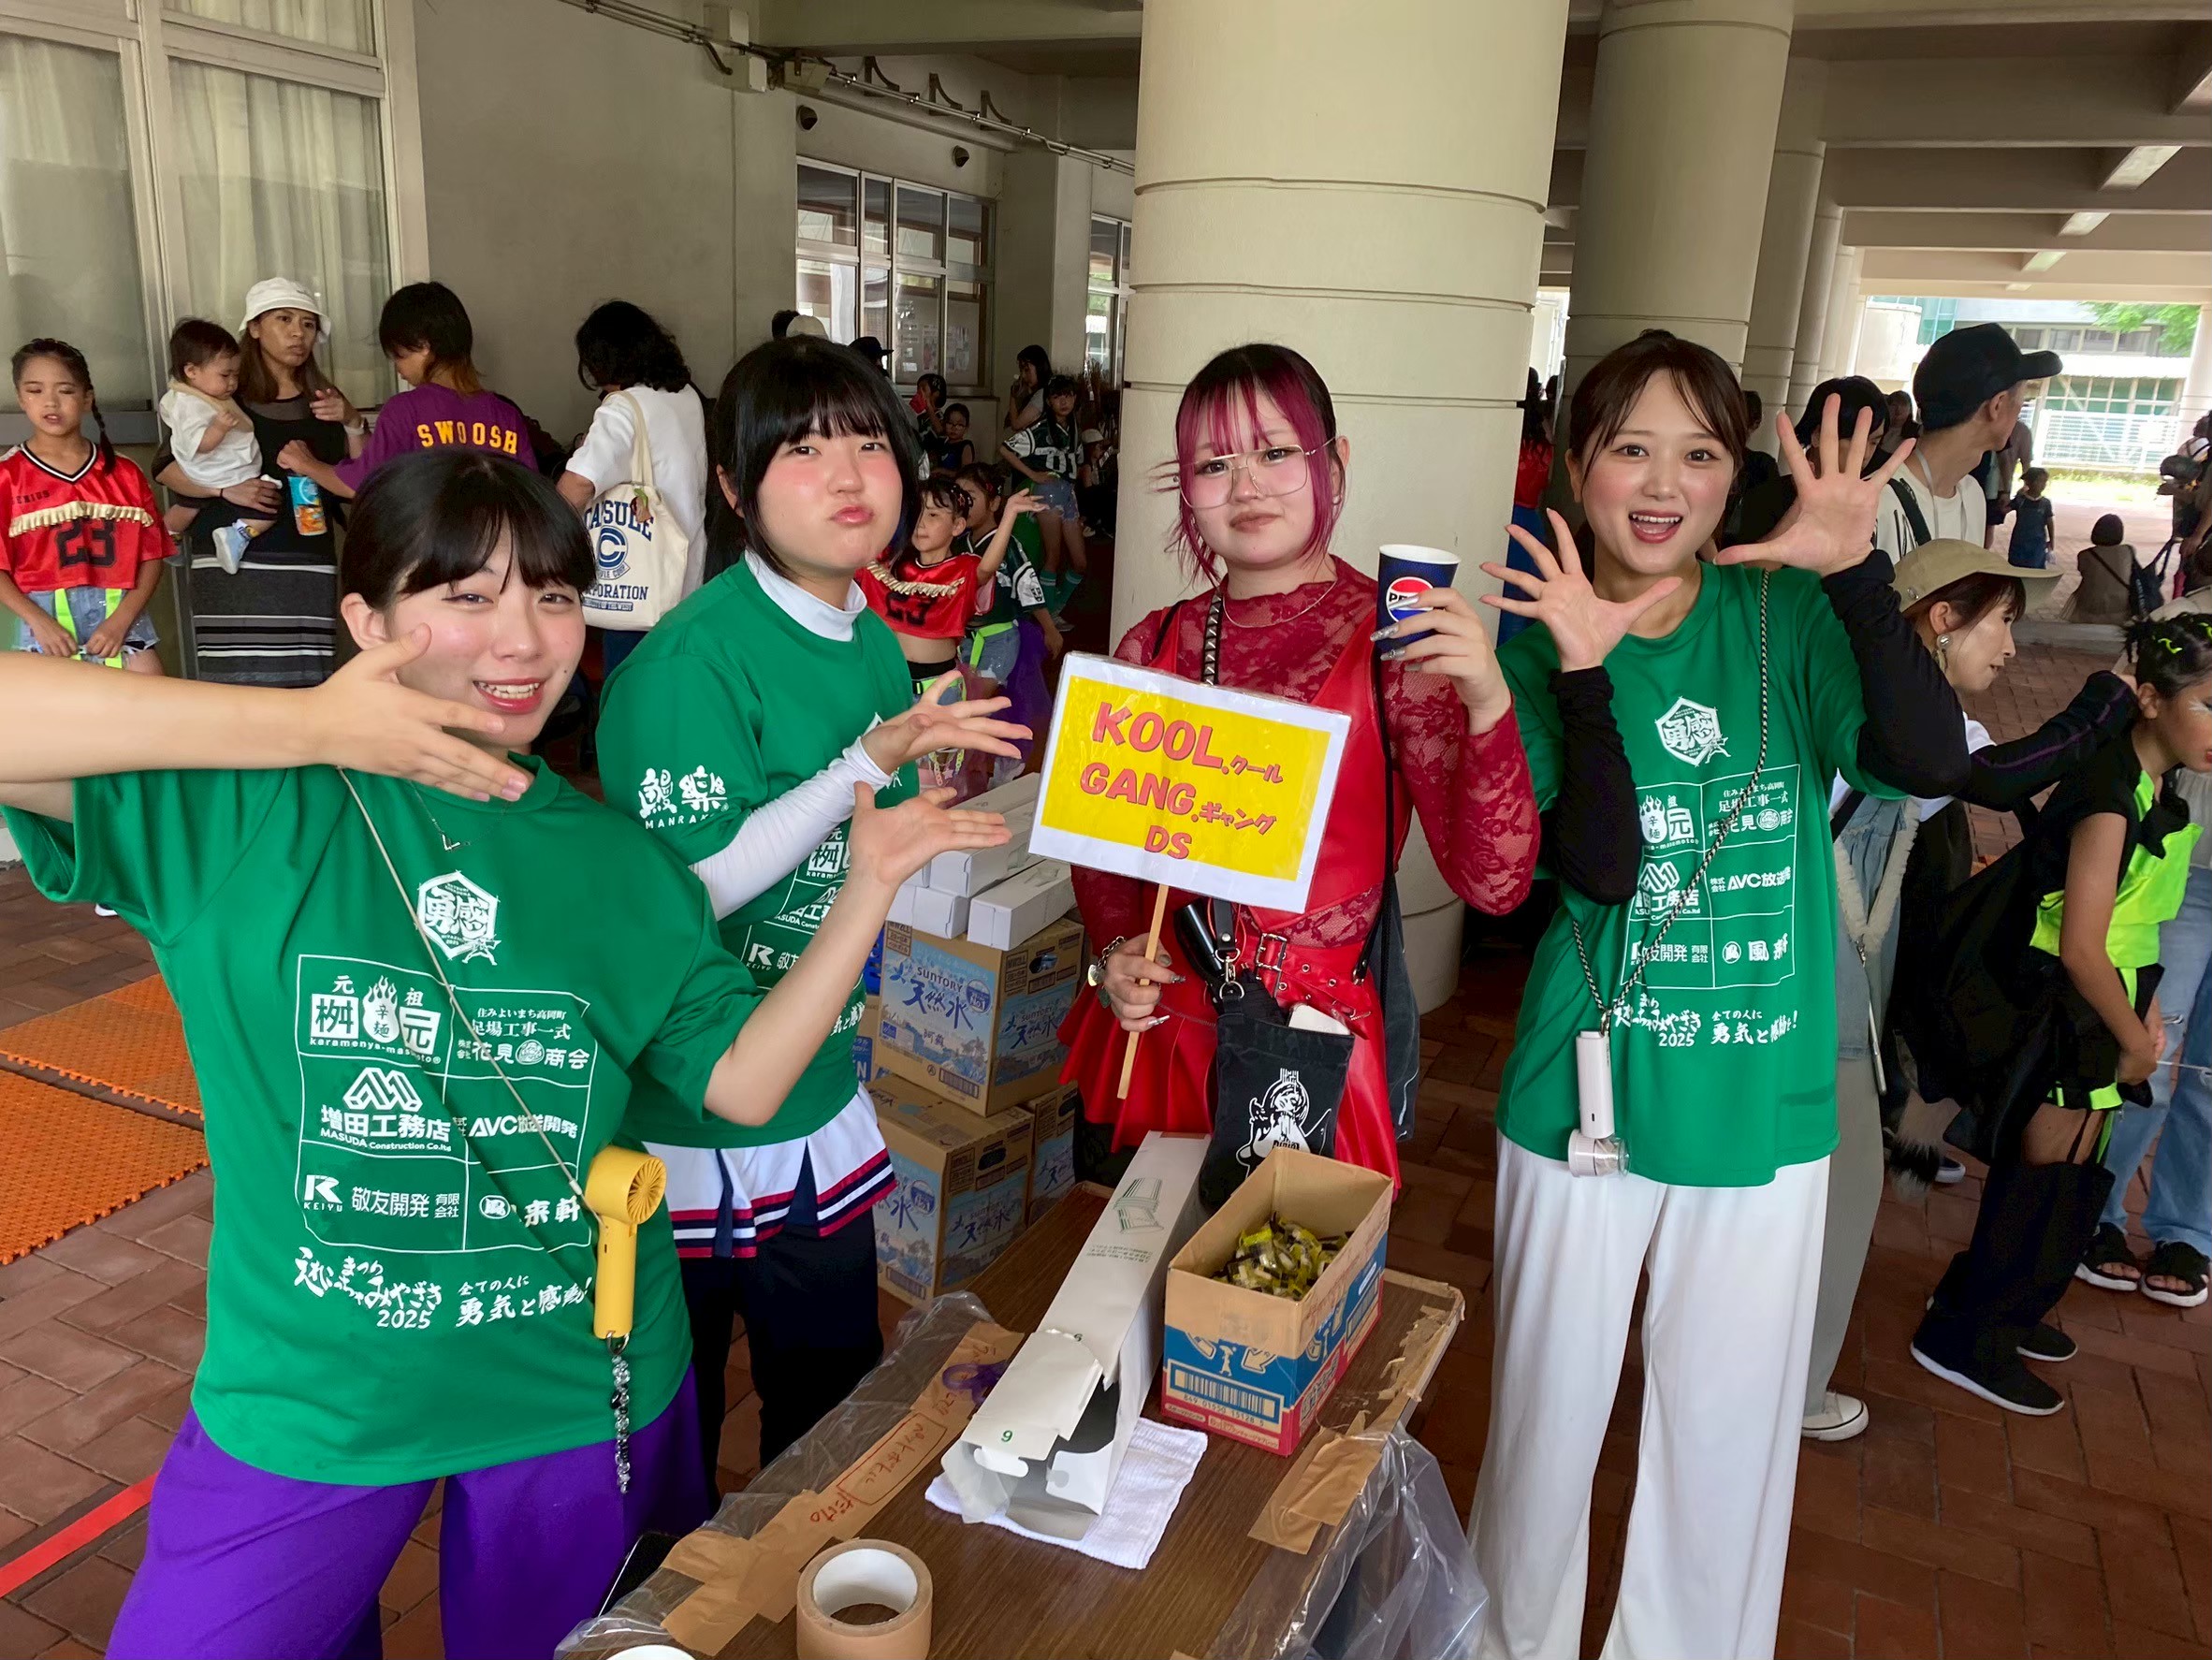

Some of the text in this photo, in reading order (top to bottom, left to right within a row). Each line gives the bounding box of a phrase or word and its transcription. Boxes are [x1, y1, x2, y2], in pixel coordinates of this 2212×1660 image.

[416, 419, 518, 455] SWOOSH
[1143, 824, 1193, 860] DS
[916, 967, 964, 993] SUNTORY
[902, 978, 974, 1031] 天然水
[1711, 1010, 1763, 1022] 全ての人に
[1658, 1032, 1696, 1047] 2025
[320, 1104, 452, 1143] 増田工務店
[320, 1128, 369, 1148] MASUDA
[370, 1142, 425, 1151] Construction
[304, 1201, 343, 1212] KEIYU
[352, 1187, 430, 1217] 敬友開発
[433, 1206, 460, 1218] 会社
[458, 1274, 530, 1296] 全ての人に
[376, 1309, 432, 1330] 2025
